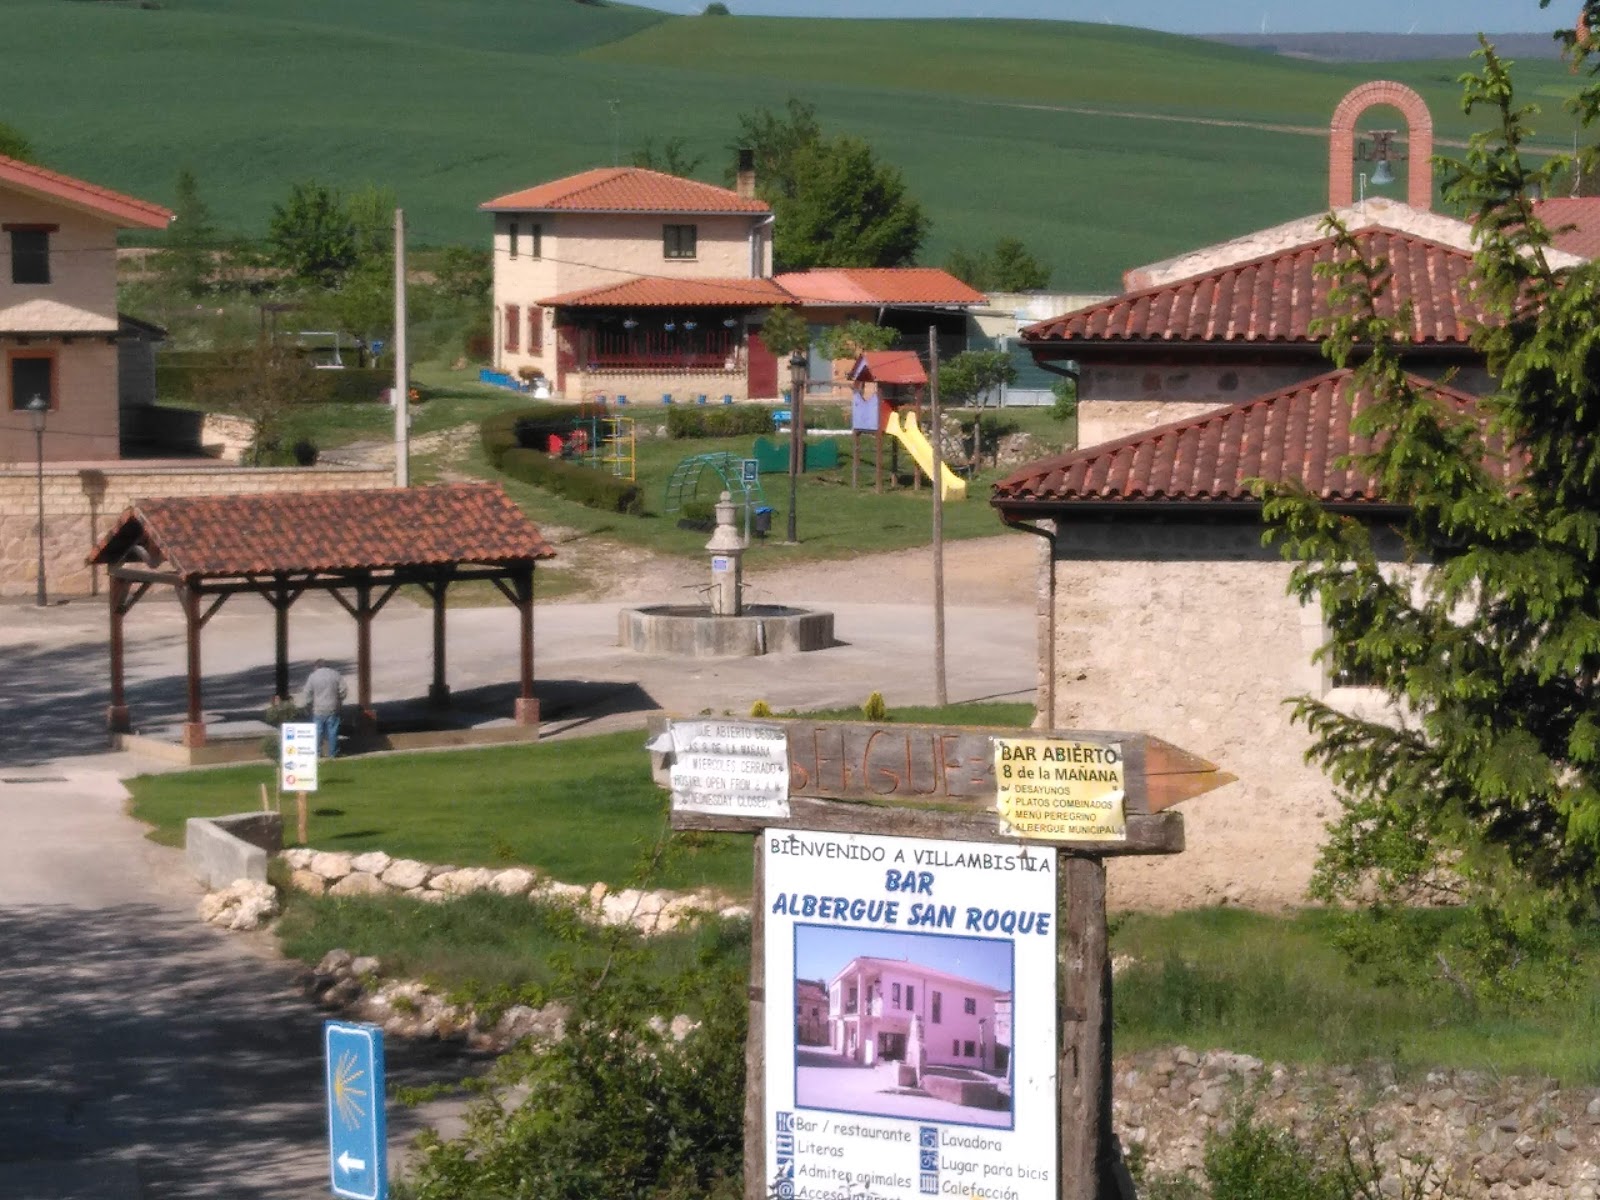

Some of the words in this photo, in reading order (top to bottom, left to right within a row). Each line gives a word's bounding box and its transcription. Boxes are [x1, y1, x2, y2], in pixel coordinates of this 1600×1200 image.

[716, 725, 752, 740] ABIERTO
[1001, 745, 1037, 761] BAR
[1042, 746, 1118, 765] ABIERTO
[740, 760, 776, 775] CERRADO
[1003, 764, 1013, 779] 8
[1017, 766, 1035, 779] de
[1038, 766, 1051, 780] la
[1054, 765, 1119, 783] MAÑANA
[705, 776, 726, 790] OPEN
[730, 778, 751, 791] FROM
[1014, 784, 1071, 796] DESAYUNOS
[1015, 798, 1051, 808] PLATOS
[1052, 799, 1114, 810] COMBINADOS
[1044, 810, 1097, 821] PEREGRINO
[1015, 823, 1065, 834] ALBERGUE
[1068, 824, 1117, 835] MUNICIPAL
[770, 837, 886, 862] BIENVENIDO
[894, 849, 905, 863] A
[885, 868, 936, 896] BAR
[771, 892, 900, 924] ALBERGUE
[907, 902, 957, 928] SAN
[965, 906, 1052, 936] ROQUE
[796, 1116, 818, 1132] Bar
[833, 1121, 912, 1142] restaurante
[797, 1139, 845, 1158] Literas
[941, 1131, 1002, 1151] Lavadora
[798, 1163, 853, 1182] Admiten
[856, 1170, 912, 1188] animales
[941, 1155, 979, 1176] Lugar
[983, 1163, 1013, 1178] para
[1017, 1163, 1049, 1181] bicis
[941, 1179, 1019, 1200] Calefacción
